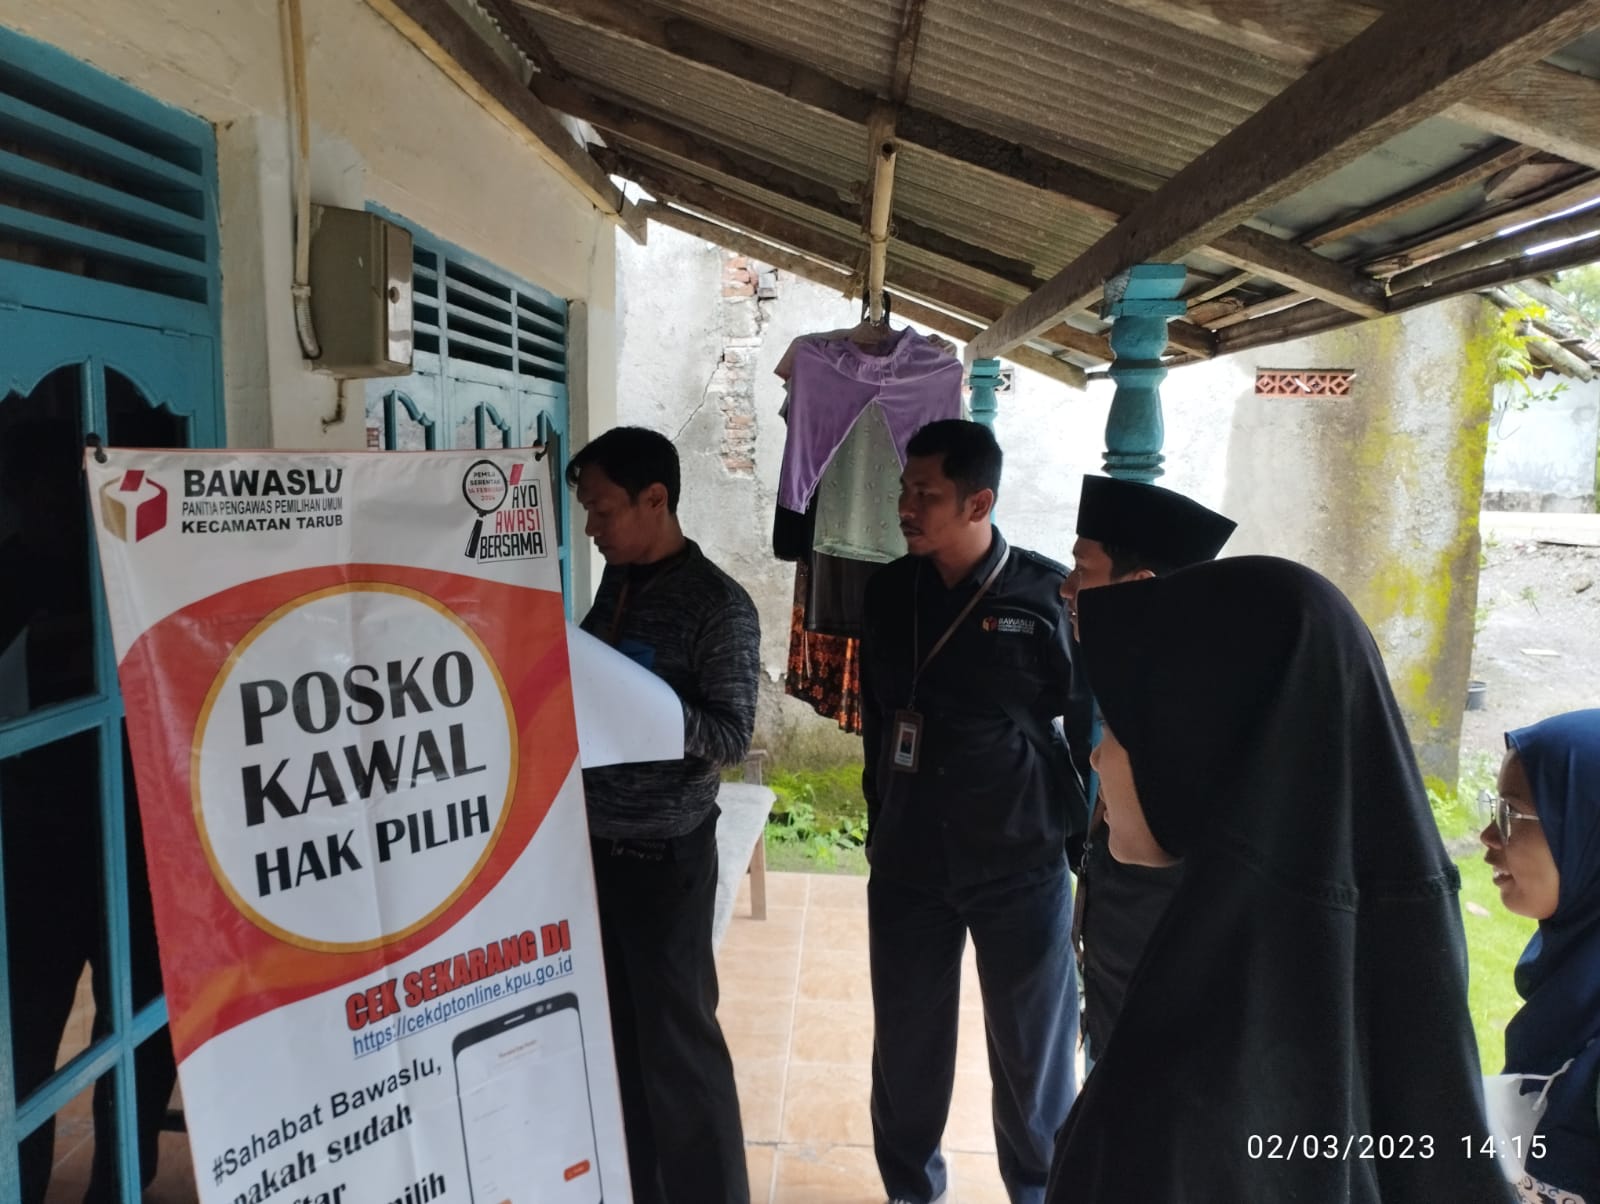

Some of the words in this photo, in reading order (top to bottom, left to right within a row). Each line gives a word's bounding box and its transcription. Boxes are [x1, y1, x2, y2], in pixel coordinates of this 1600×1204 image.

[182, 501, 219, 516] PANITIA
[220, 500, 273, 515] PENGAWAS
[275, 498, 321, 513] PEMILIHAN
[323, 496, 343, 511] UMUM
[183, 468, 343, 497] BAWASLU
[512, 485, 538, 509] AYO
[181, 518, 291, 534] KECAMATAN
[296, 514, 344, 530] TARUB
[479, 532, 544, 560] BERSAMA
[495, 509, 541, 534] AWASI
[239, 650, 475, 747] POSKO
[241, 723, 487, 828] KAWAL
[255, 830, 363, 898] HAK
[375, 795, 491, 864] PILIH
[345, 979, 401, 1032] CEK
[403, 930, 538, 1009] SEKARANG
[540, 919, 572, 957] DI
[353, 955, 573, 1058] https://cekdptonline.kpu.go.id
[212, 1104, 324, 1187] #Sahabat
[330, 1057, 442, 1119] Bawaslu,
[327, 1103, 413, 1163] sudah
